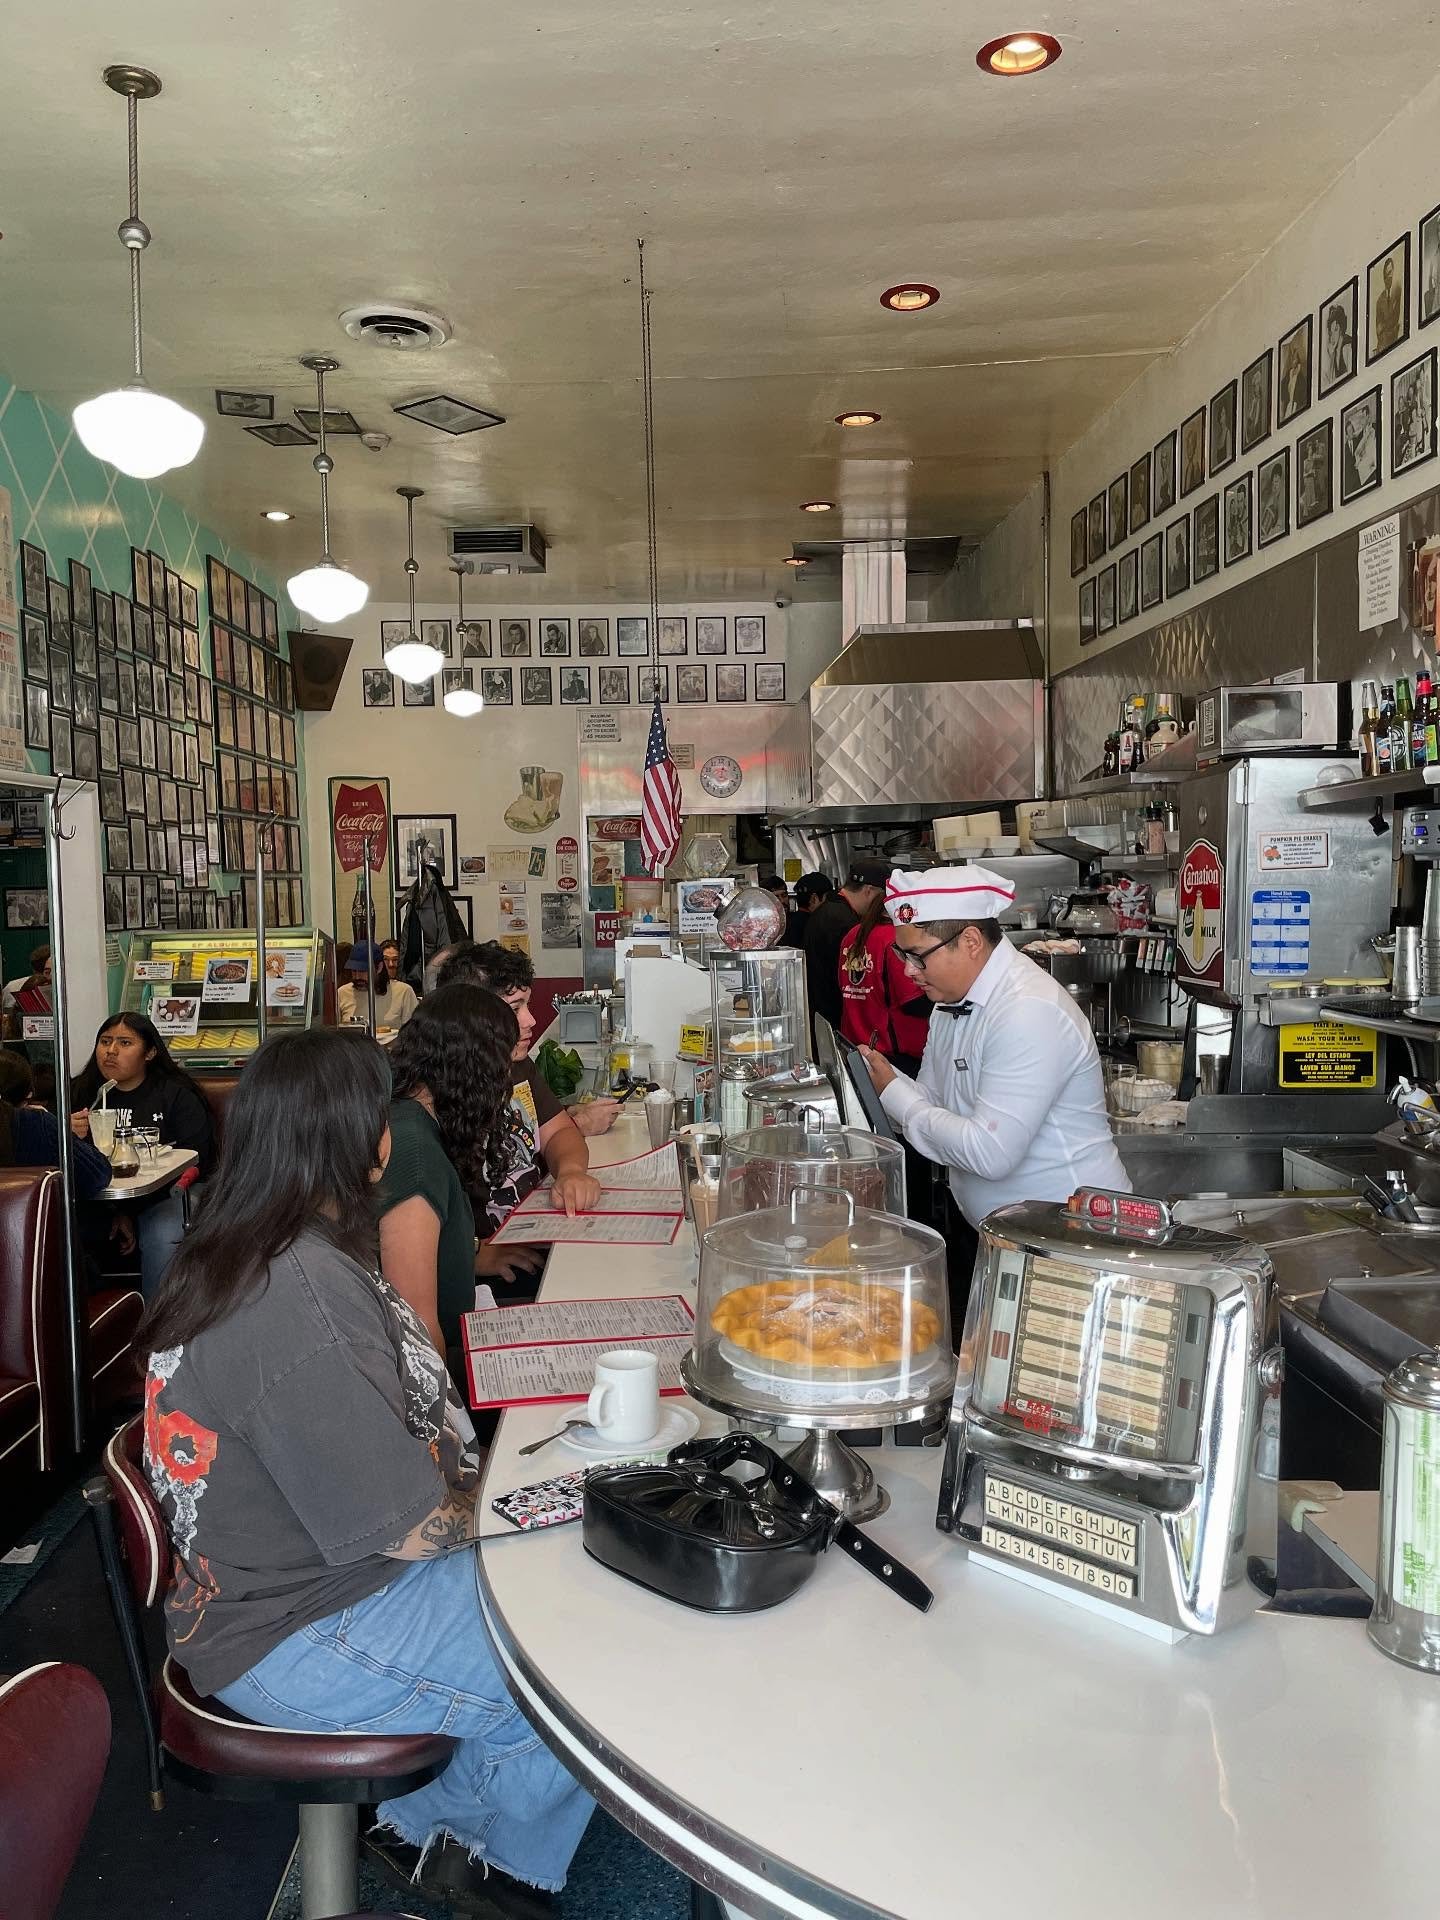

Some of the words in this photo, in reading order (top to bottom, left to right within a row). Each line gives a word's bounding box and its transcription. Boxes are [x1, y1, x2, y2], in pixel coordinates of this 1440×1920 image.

[336, 814, 385, 832] Coca-Cola
[602, 821, 638, 833] Coca-Cola
[1184, 863, 1218, 894] Carnation
[1201, 927, 1216, 938] MILK
[1093, 1199, 1111, 1213] COINS
[988, 1482, 996, 1494] A
[1002, 1486, 1009, 1499] B
[1016, 1492, 1024, 1504] C
[1031, 1497, 1038, 1509] D
[1045, 1502, 1053, 1514] E
[1060, 1507, 1068, 1518] F
[1074, 1512, 1083, 1524] G
[1090, 1518, 1098, 1530] H
[1106, 1522, 1114, 1535] J
[1122, 1528, 1130, 1541] K
[988, 1502, 996, 1514] L
[1002, 1506, 1010, 1518] M
[1016, 1512, 1024, 1524] N
[1030, 1516, 1038, 1528] P
[1045, 1522, 1054, 1534] Q
[1060, 1527, 1068, 1539] R
[1075, 1532, 1083, 1544] S
[1091, 1537, 1099, 1550] T
[1106, 1543, 1114, 1555] U
[1121, 1547, 1130, 1560] V
[985, 1531, 990, 1543] 1
[999, 1536, 1007, 1549] 2
[1014, 1542, 1021, 1554] 3
[1028, 1547, 1035, 1559] 4
[1042, 1552, 1050, 1565] 5
[1056, 1558, 1065, 1570] 6
[1072, 1564, 1080, 1575] 7
[1087, 1569, 1095, 1582] 8
[1102, 1575, 1111, 1587] 9
[1118, 1581, 1127, 1593] 0
